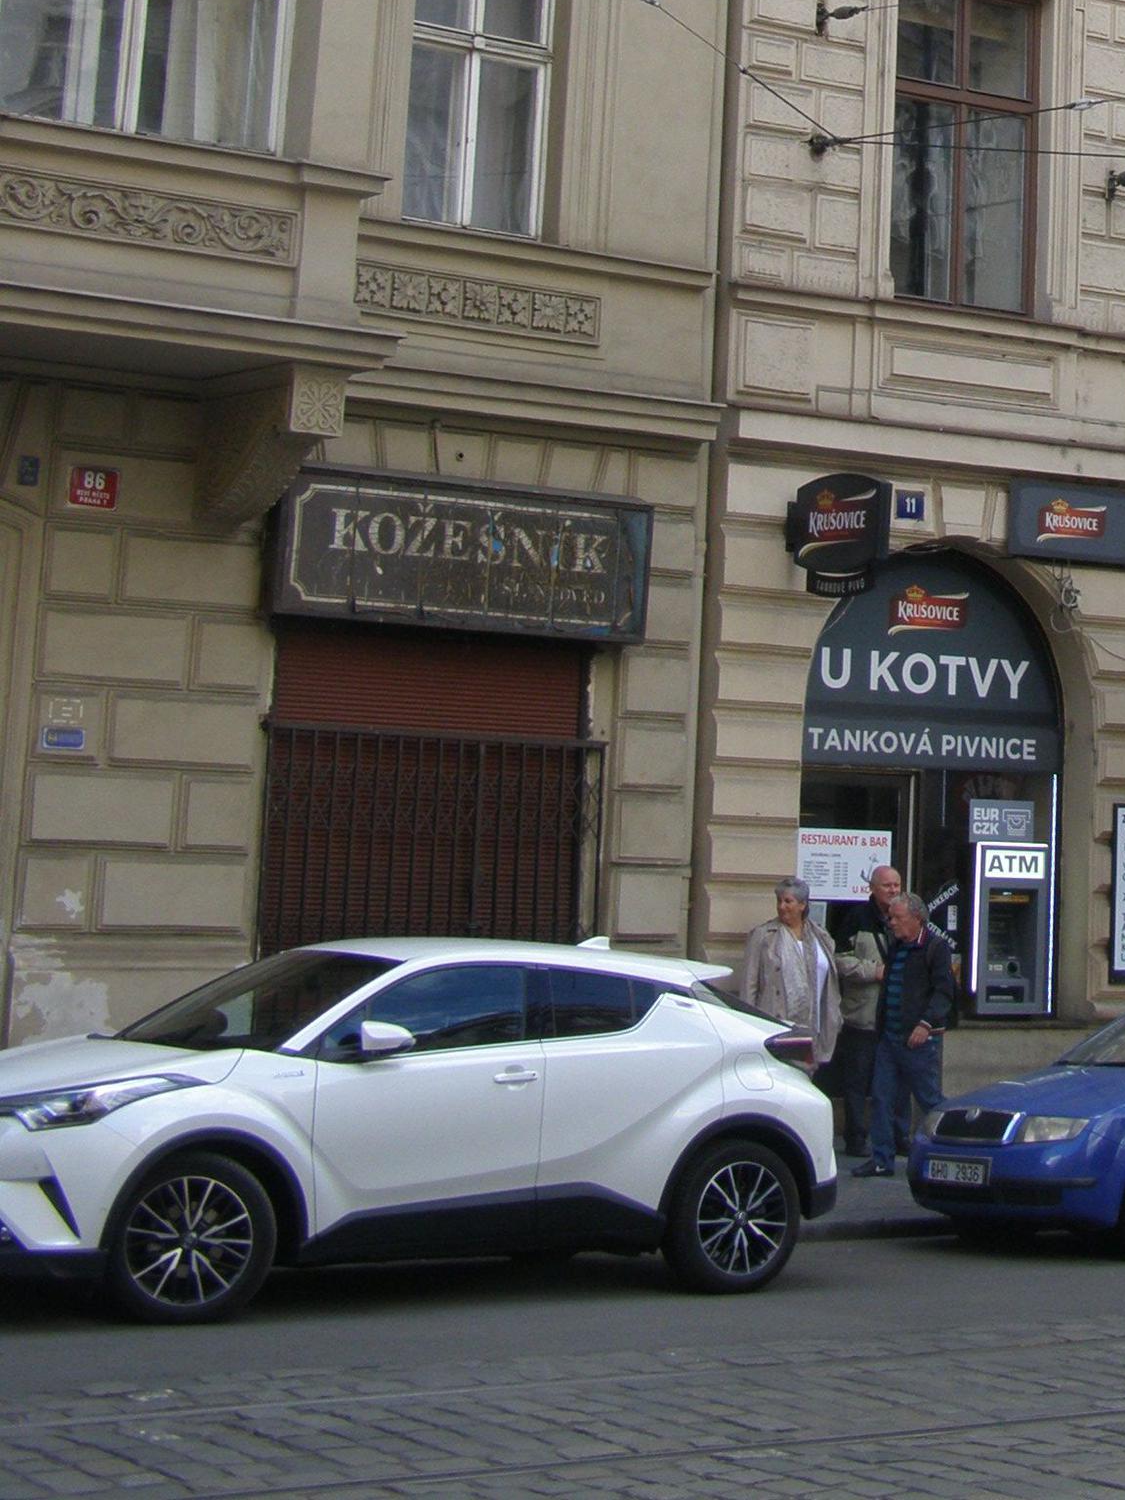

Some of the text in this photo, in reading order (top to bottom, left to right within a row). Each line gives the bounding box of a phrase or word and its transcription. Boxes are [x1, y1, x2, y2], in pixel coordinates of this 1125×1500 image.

[84, 471, 105, 490] 86
[904, 498, 916, 514] 11
[809, 510, 866, 537] KRUŠOVICE
[1045, 511, 1099, 533] KRUŠOVICE
[898, 600, 960, 622] KRUŠOVICE
[820, 646, 1031, 700] U KOTVY
[808, 726, 1038, 761] TANKOVÁ PIVNICE
[973, 807, 1000, 821] EUR
[972, 821, 1000, 836] CZK
[801, 833, 889, 848] RESTAURANT & BAR
[988, 854, 1040, 874] ATM
